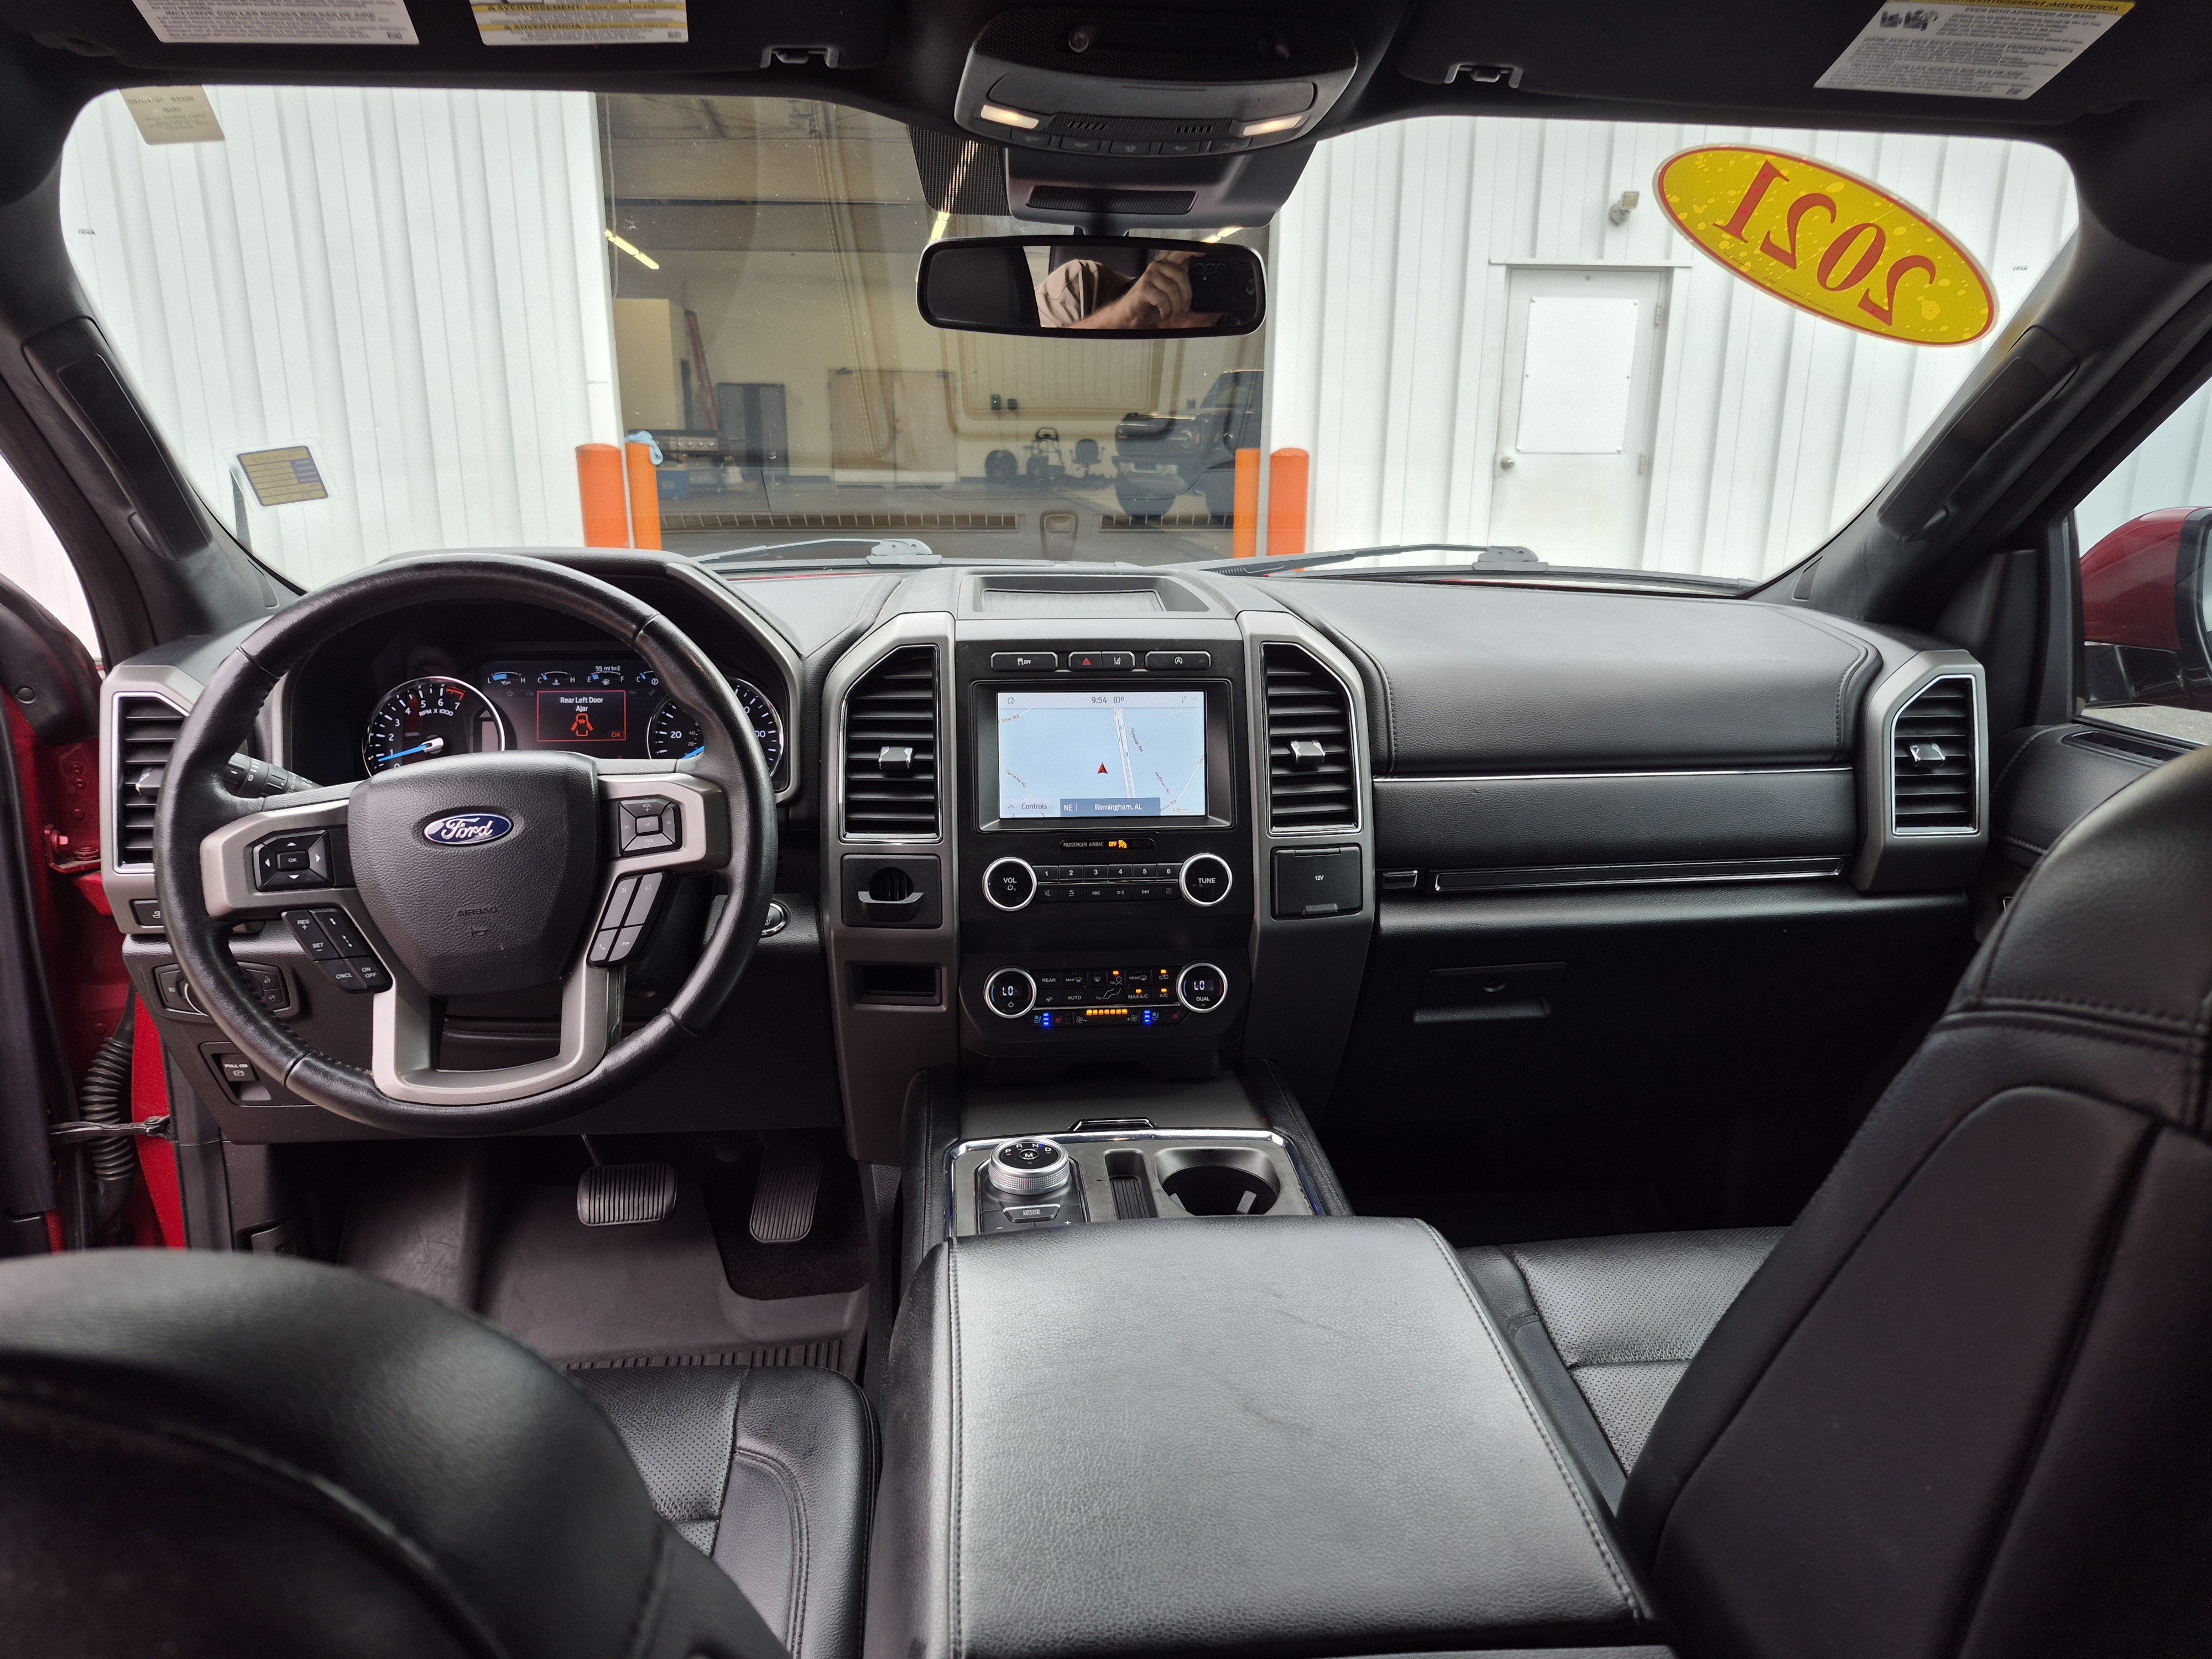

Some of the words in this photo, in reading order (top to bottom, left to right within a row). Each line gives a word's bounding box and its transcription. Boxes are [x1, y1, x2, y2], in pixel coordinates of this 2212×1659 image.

[420, 700, 426, 708] 5
[437, 698, 444, 707] 6
[405, 707, 411, 715] 4
[394, 718, 400, 727] 3
[389, 733, 394, 742] 2
[441, 817, 494, 839] Ford
[457, 907, 497, 916] AIRBAG
[1194, 980, 1205, 990] LO
[1003, 985, 1014, 995] LO
